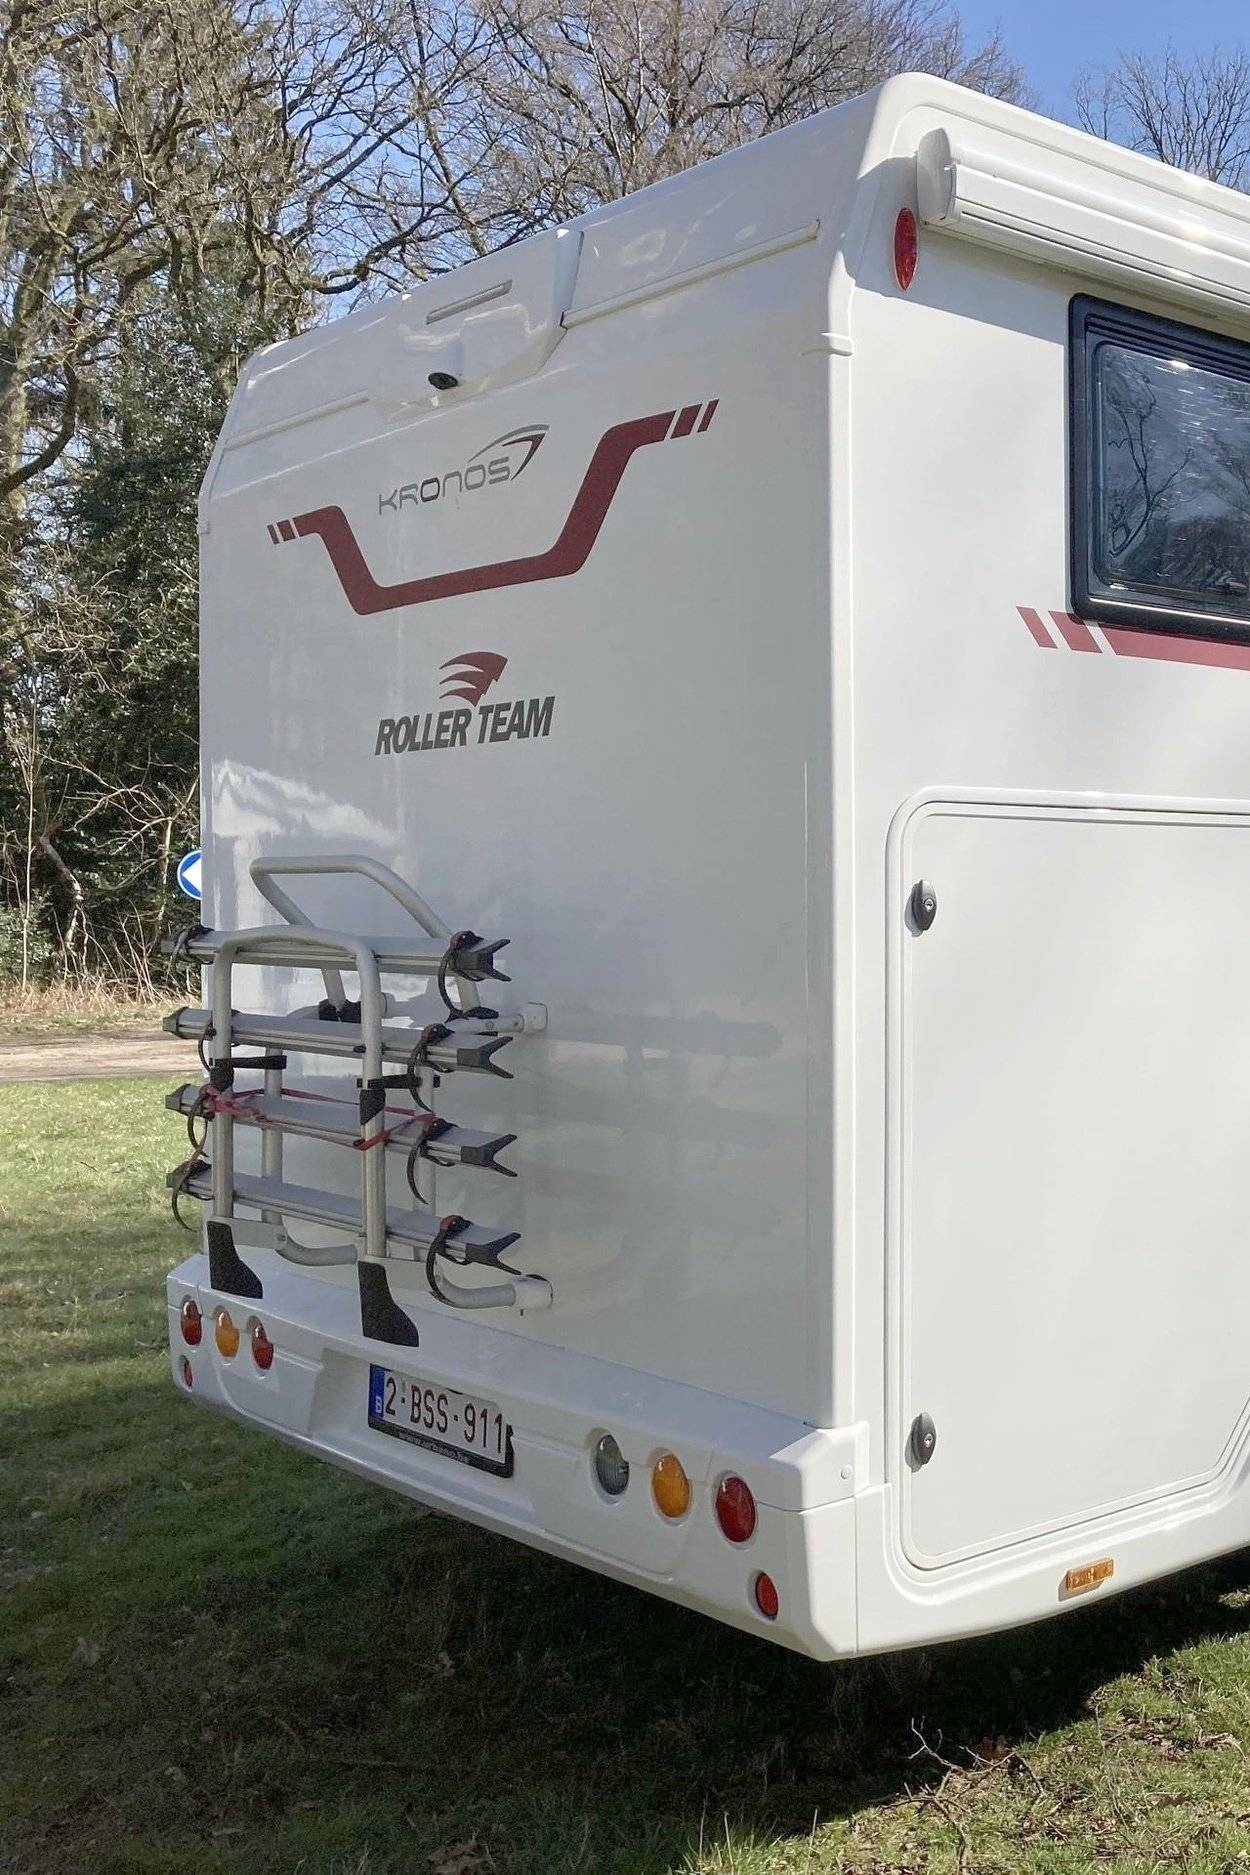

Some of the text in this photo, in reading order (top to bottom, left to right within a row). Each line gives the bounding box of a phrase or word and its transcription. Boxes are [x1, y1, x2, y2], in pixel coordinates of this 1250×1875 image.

[379, 456, 511, 516] KRONOS
[375, 696, 555, 756] ROLLER TEAM
[375, 1396, 384, 1414] B
